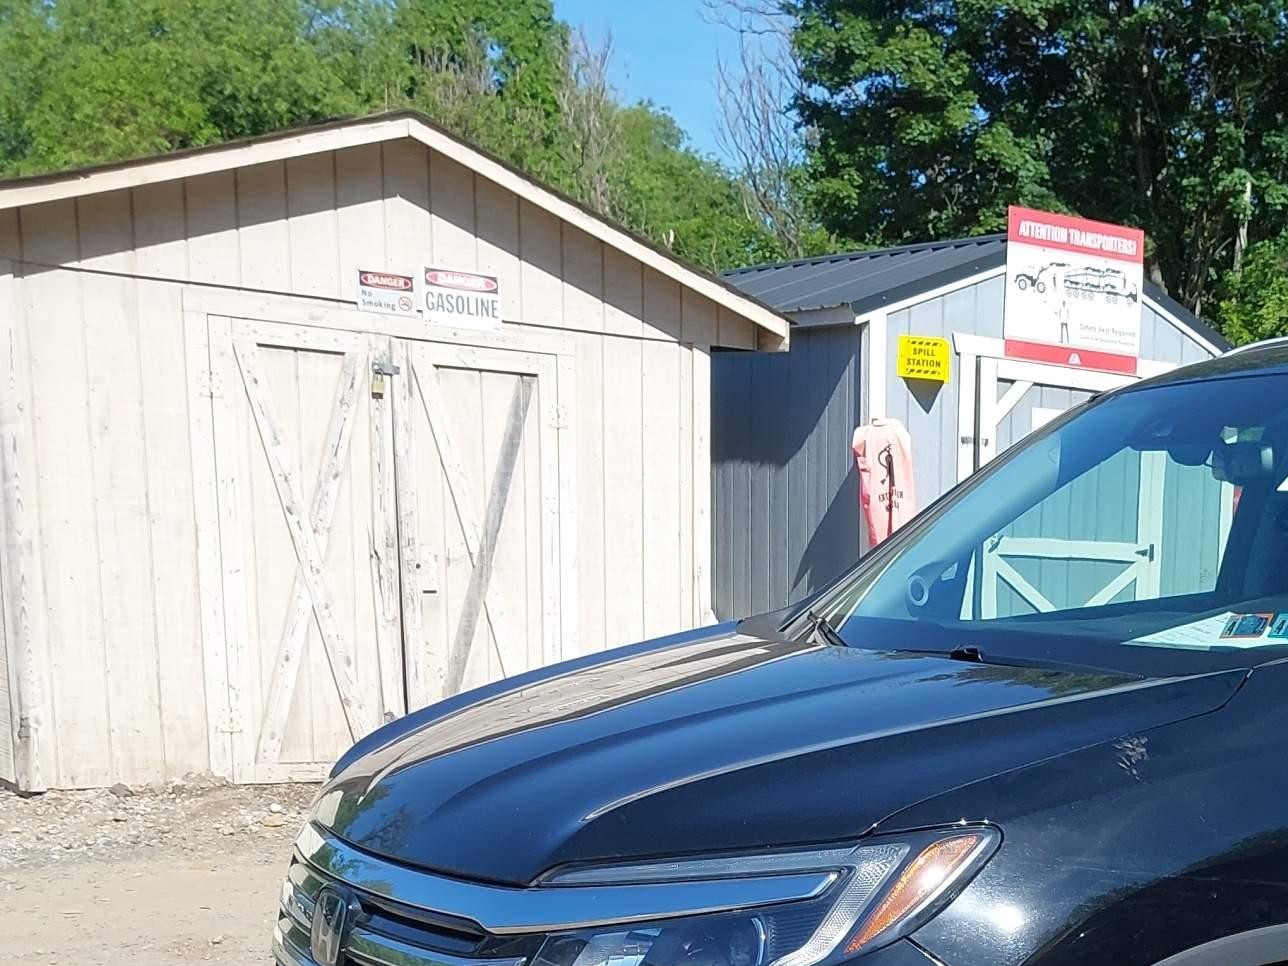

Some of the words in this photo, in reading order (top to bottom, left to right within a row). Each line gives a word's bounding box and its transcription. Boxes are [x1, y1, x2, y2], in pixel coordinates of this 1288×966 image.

[1019, 220, 1067, 244] ATTENTION
[1068, 229, 1137, 255] TRANSPORTERS!
[368, 274, 404, 287] DANGER
[361, 288, 373, 297] No
[362, 299, 396, 311] Smoking
[425, 291, 499, 319] GASOLINE
[912, 347, 936, 357] SPILL
[906, 358, 941, 368] STATION
